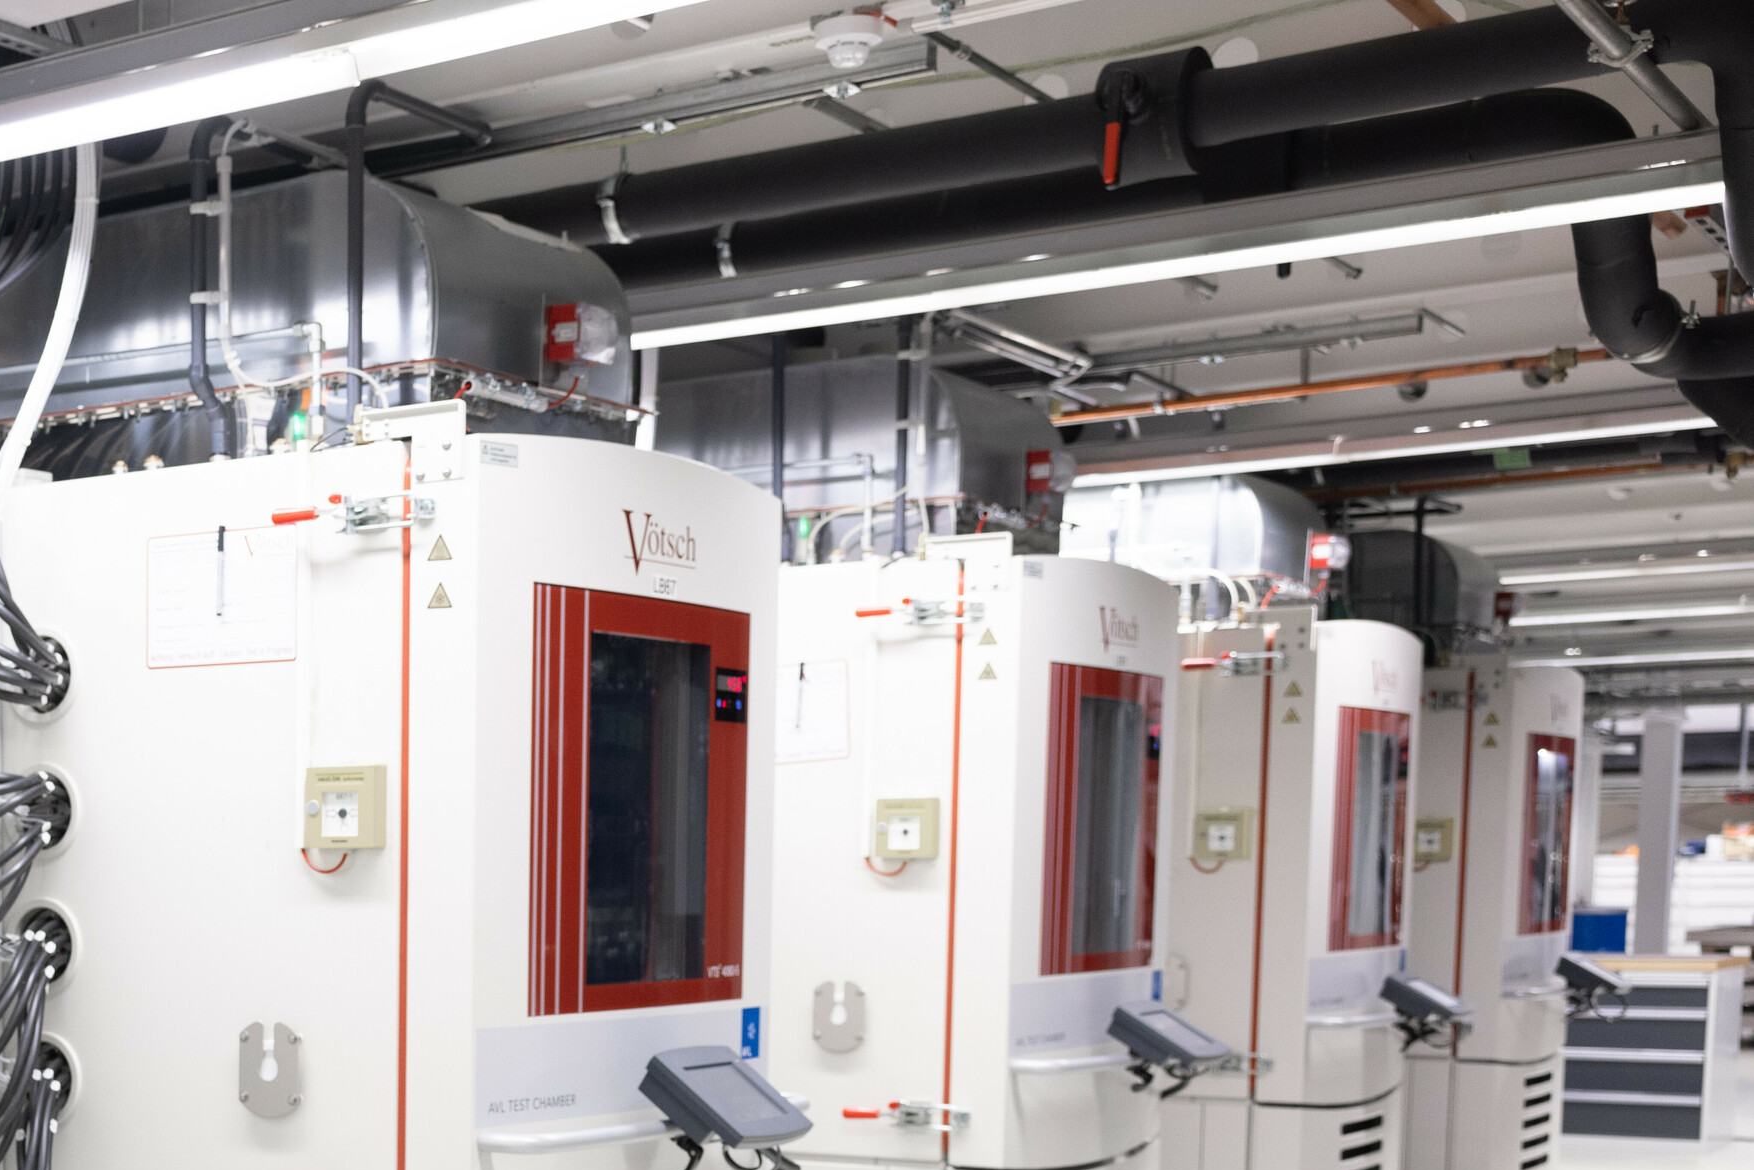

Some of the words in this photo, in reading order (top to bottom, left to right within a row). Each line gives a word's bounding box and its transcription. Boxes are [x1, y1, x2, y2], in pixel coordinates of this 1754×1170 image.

[622, 509, 696, 576] Vötsch
[508, 1097, 531, 1113] TEST
[532, 1093, 577, 1110] CHAMBER
